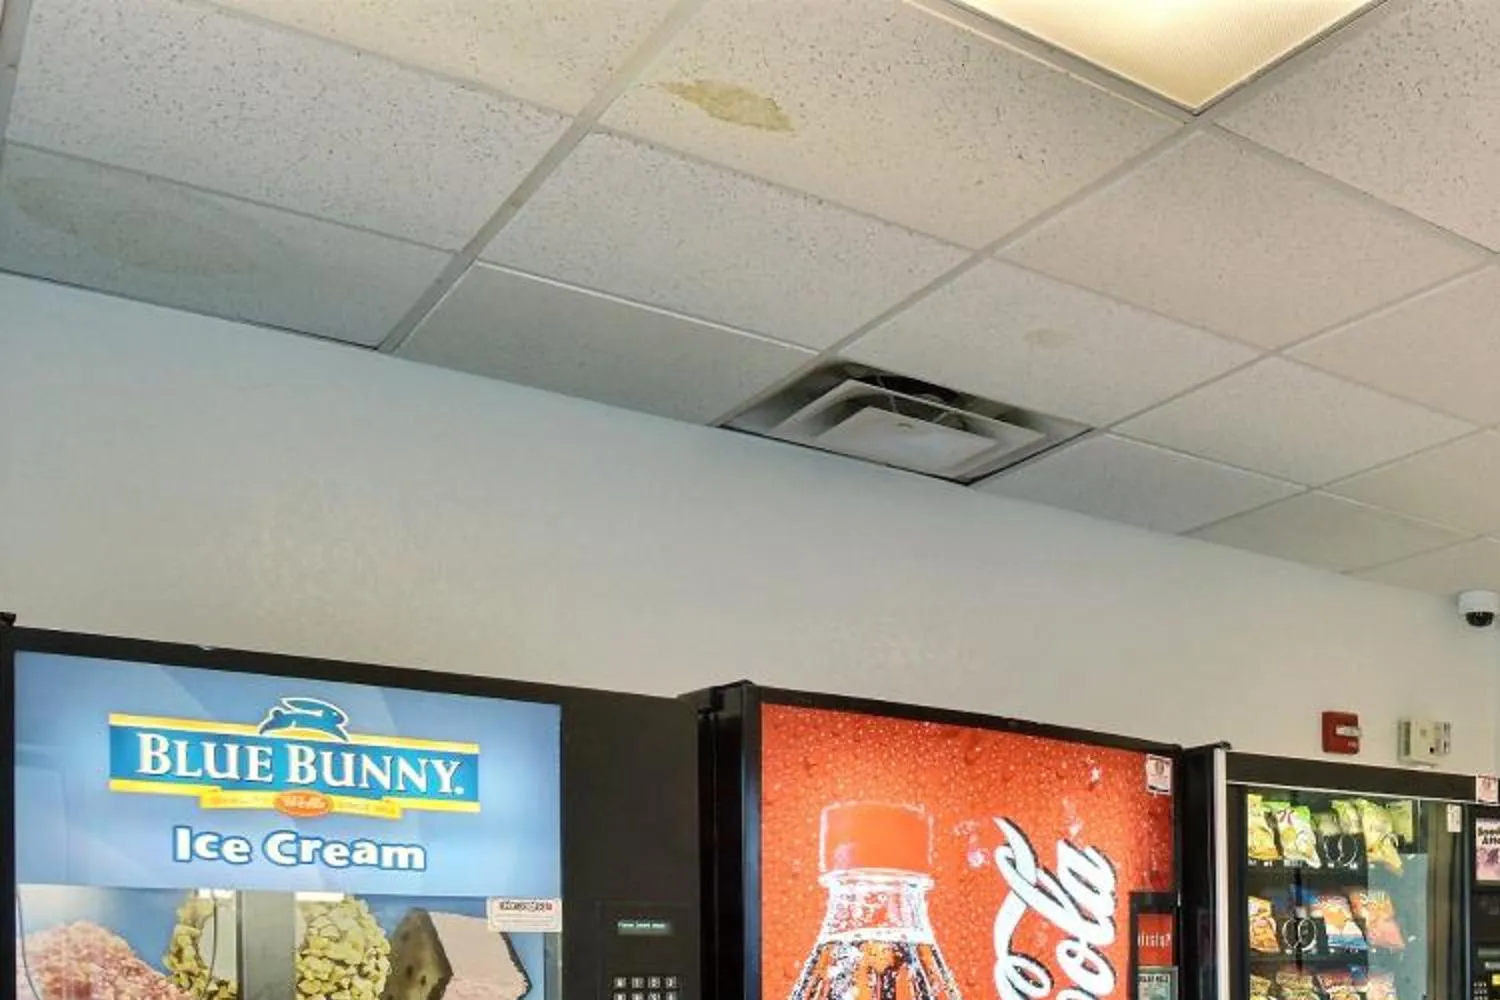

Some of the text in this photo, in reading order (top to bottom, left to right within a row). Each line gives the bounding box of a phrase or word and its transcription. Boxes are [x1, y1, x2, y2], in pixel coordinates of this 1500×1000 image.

[137, 733, 273, 784] BLUE
[172, 825, 427, 870] Ice Cream
